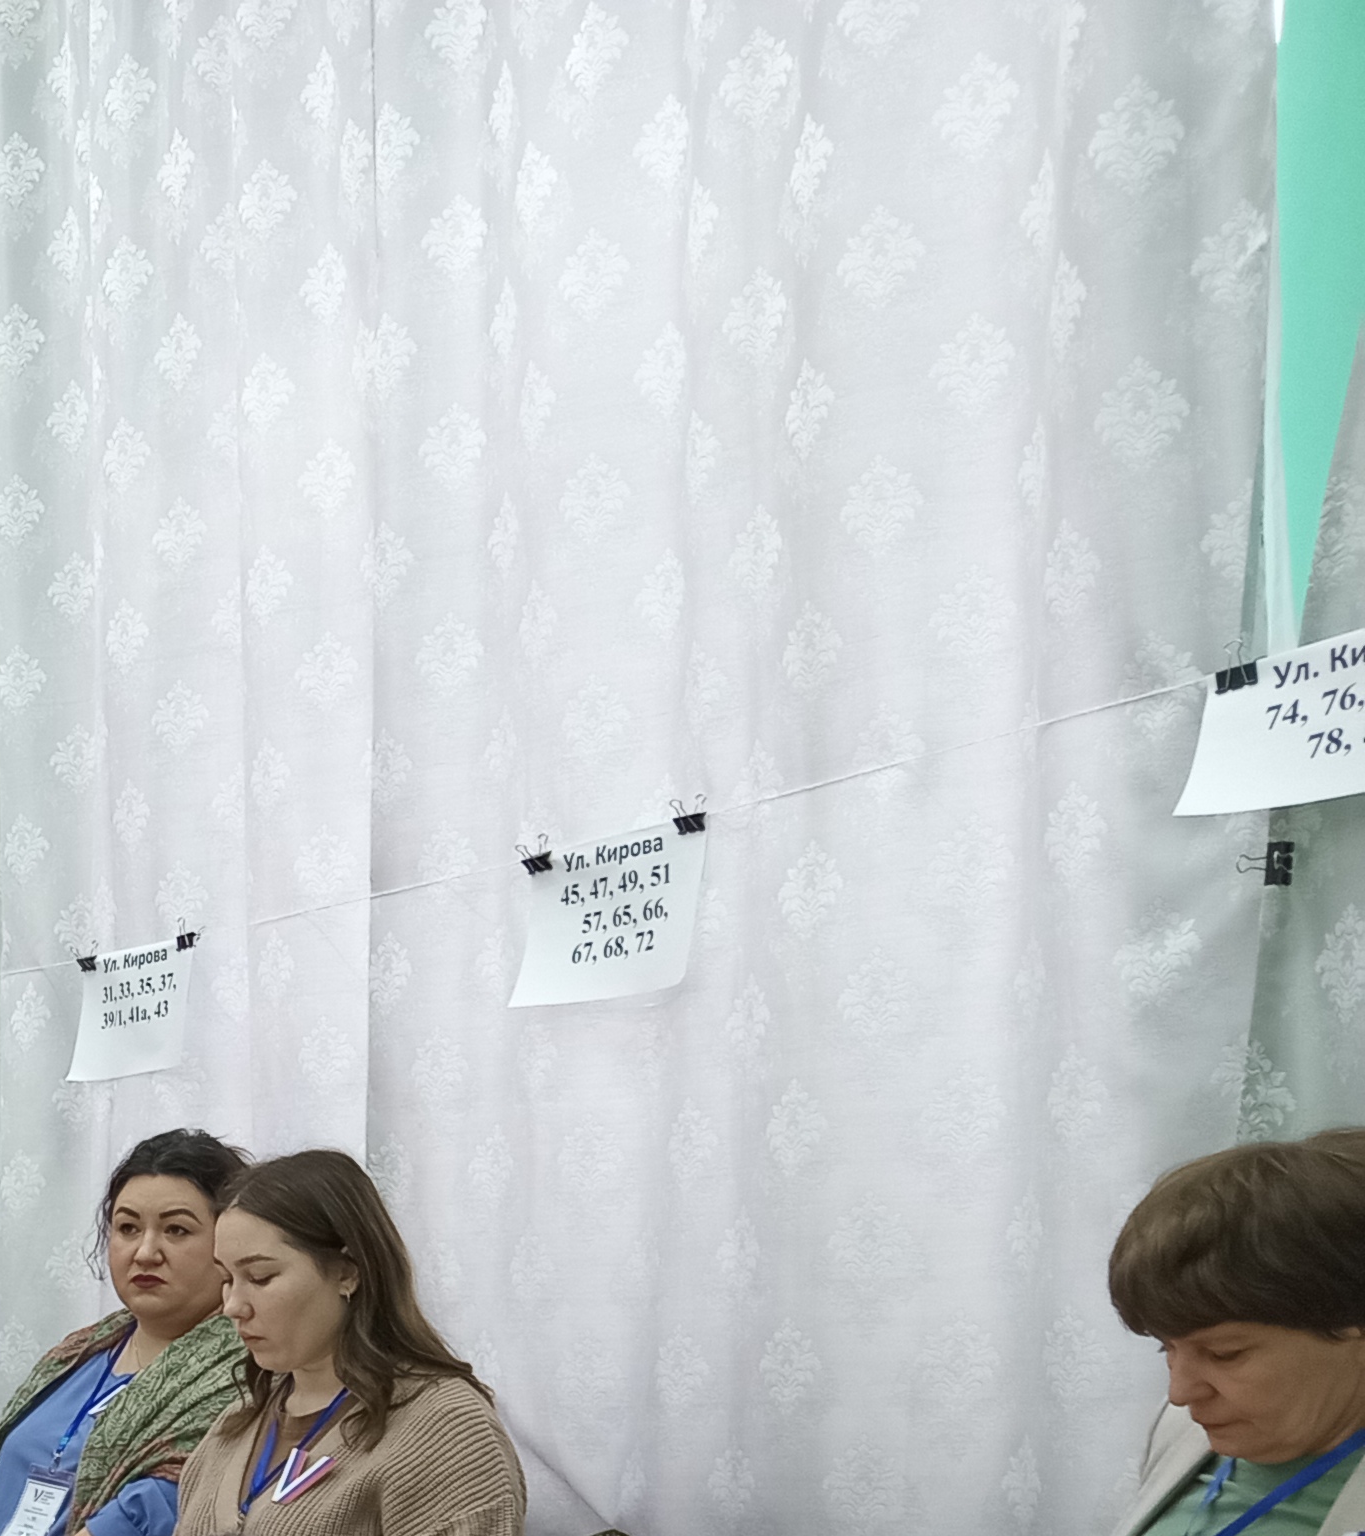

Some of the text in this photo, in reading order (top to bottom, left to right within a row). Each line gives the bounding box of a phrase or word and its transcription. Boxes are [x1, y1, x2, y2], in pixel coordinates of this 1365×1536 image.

[1272, 661, 1319, 689] Ул.
[1266, 682, 1364, 729] 74, 76,
[1307, 727, 1352, 759] 78,
[563, 836, 663, 873] Ул. Кирова
[560, 863, 670, 907] 45, 47, 49, 51
[581, 897, 668, 934] 57, 65, 66,
[102, 948, 168, 973] Ул. Кирова
[571, 929, 654, 965] 67, 68, 72
[137, 976, 155, 996] 35,
[158, 972, 177, 992] 37,
[154, 1000, 169, 1018] 43
